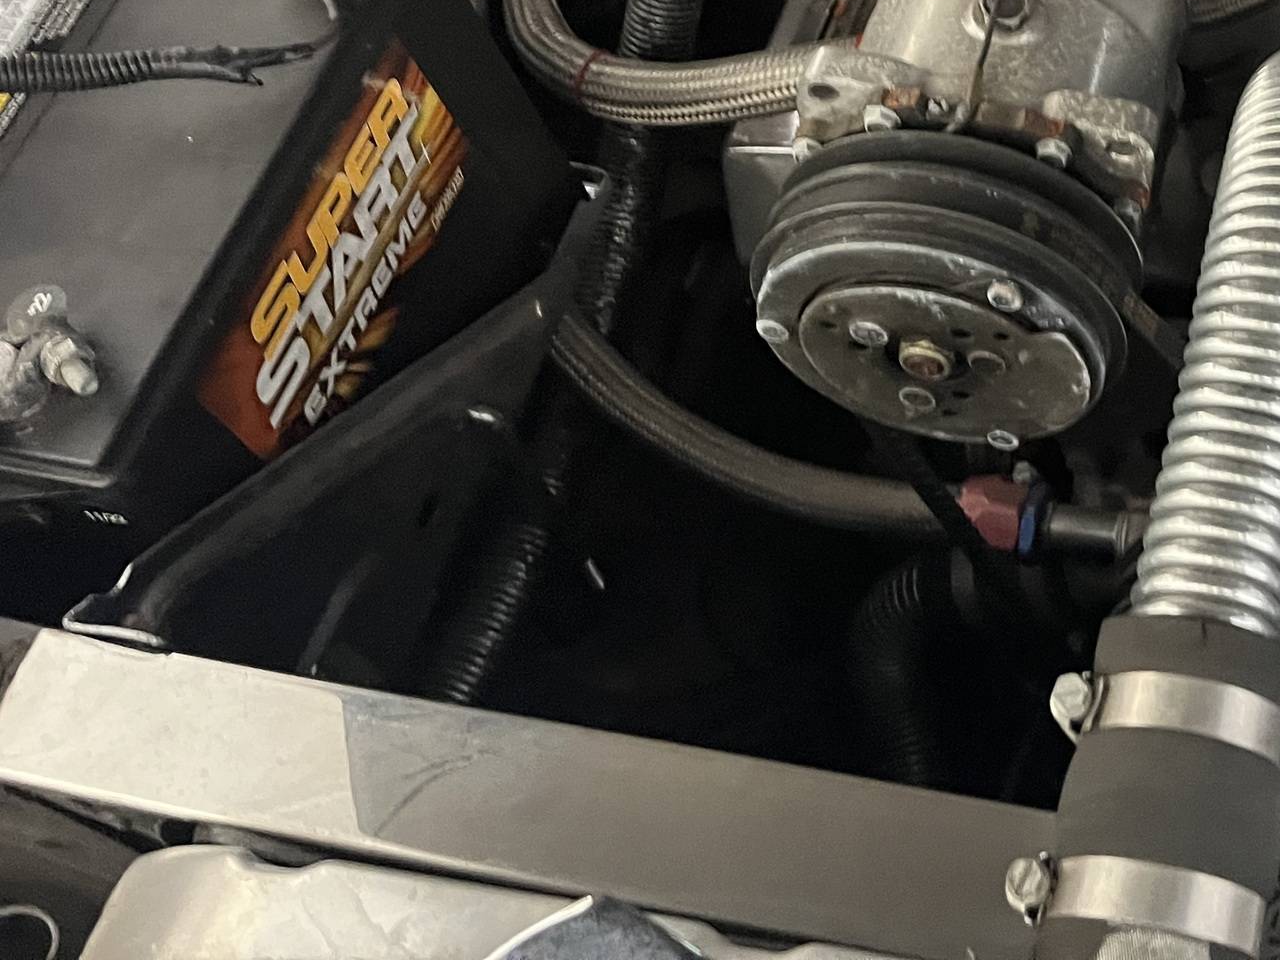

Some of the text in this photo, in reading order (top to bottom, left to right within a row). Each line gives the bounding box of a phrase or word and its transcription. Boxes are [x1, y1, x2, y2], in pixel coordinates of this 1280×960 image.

[250, 77, 410, 363] SUPER
[256, 101, 420, 430] START
[304, 191, 428, 426] EXTREME
